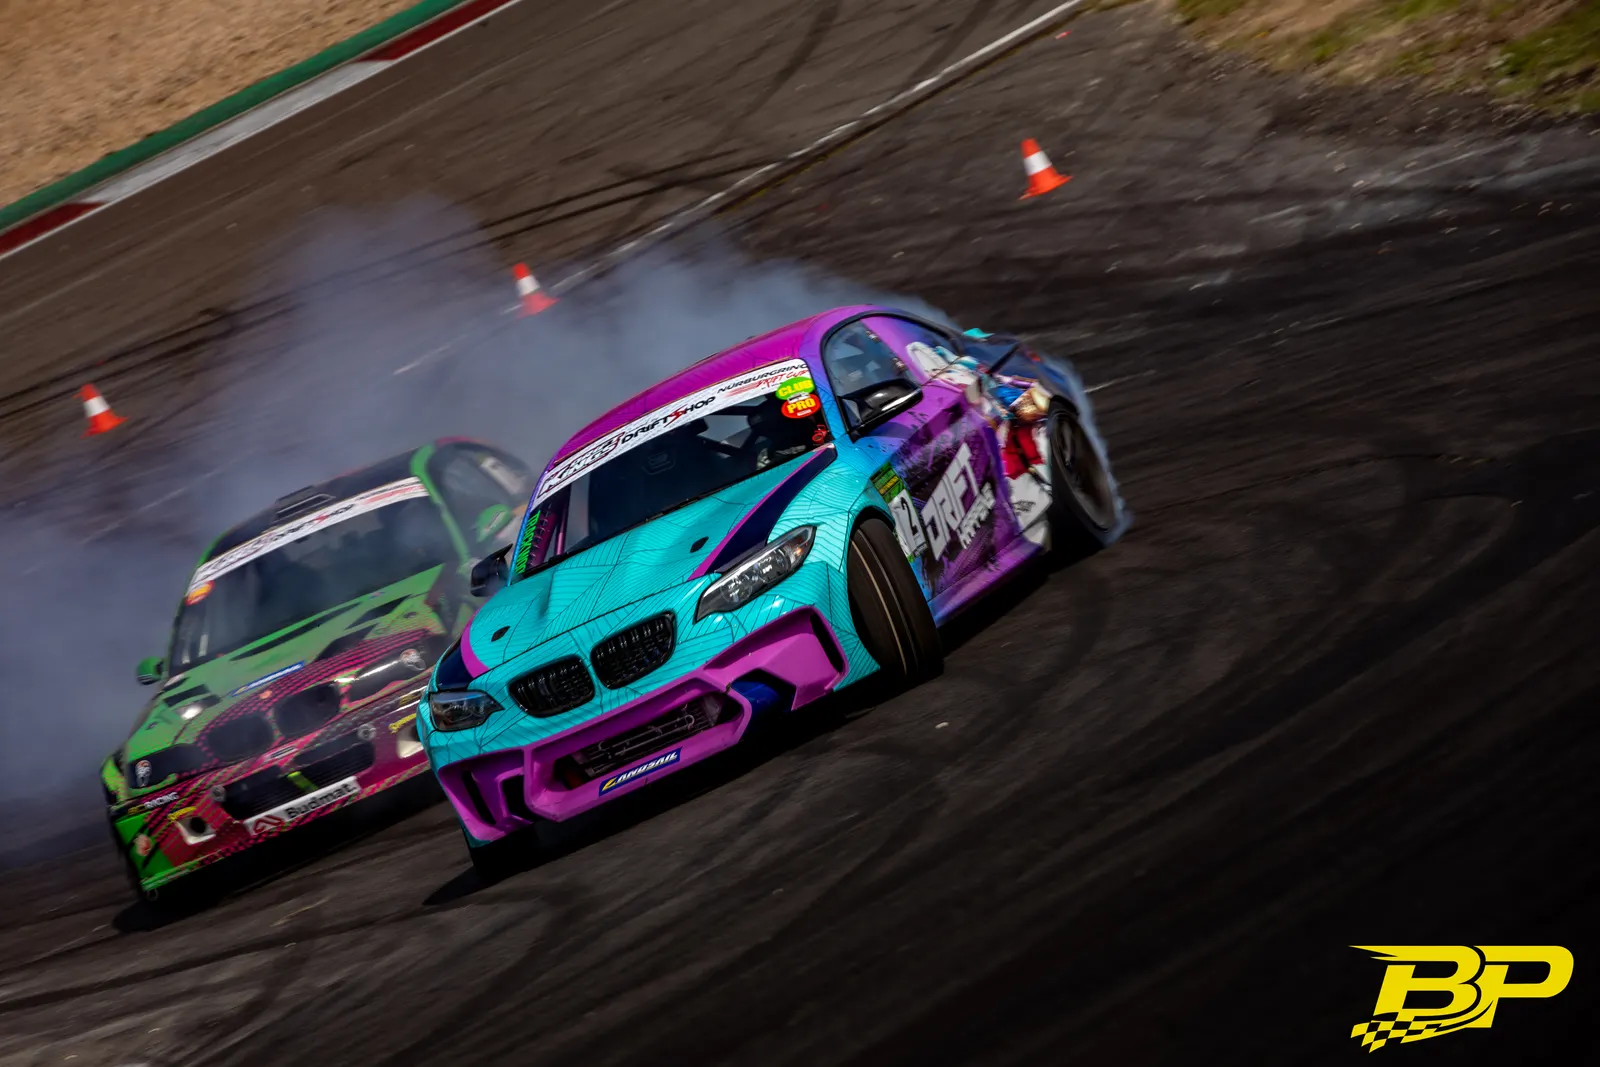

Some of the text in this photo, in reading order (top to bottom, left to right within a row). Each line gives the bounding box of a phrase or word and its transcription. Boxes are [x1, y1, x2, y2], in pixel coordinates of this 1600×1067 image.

[778, 379, 814, 397] CLUB
[787, 397, 816, 414] PRO
[620, 396, 716, 445] DRIFTSHOP
[601, 751, 678, 792] LANDSAIL
